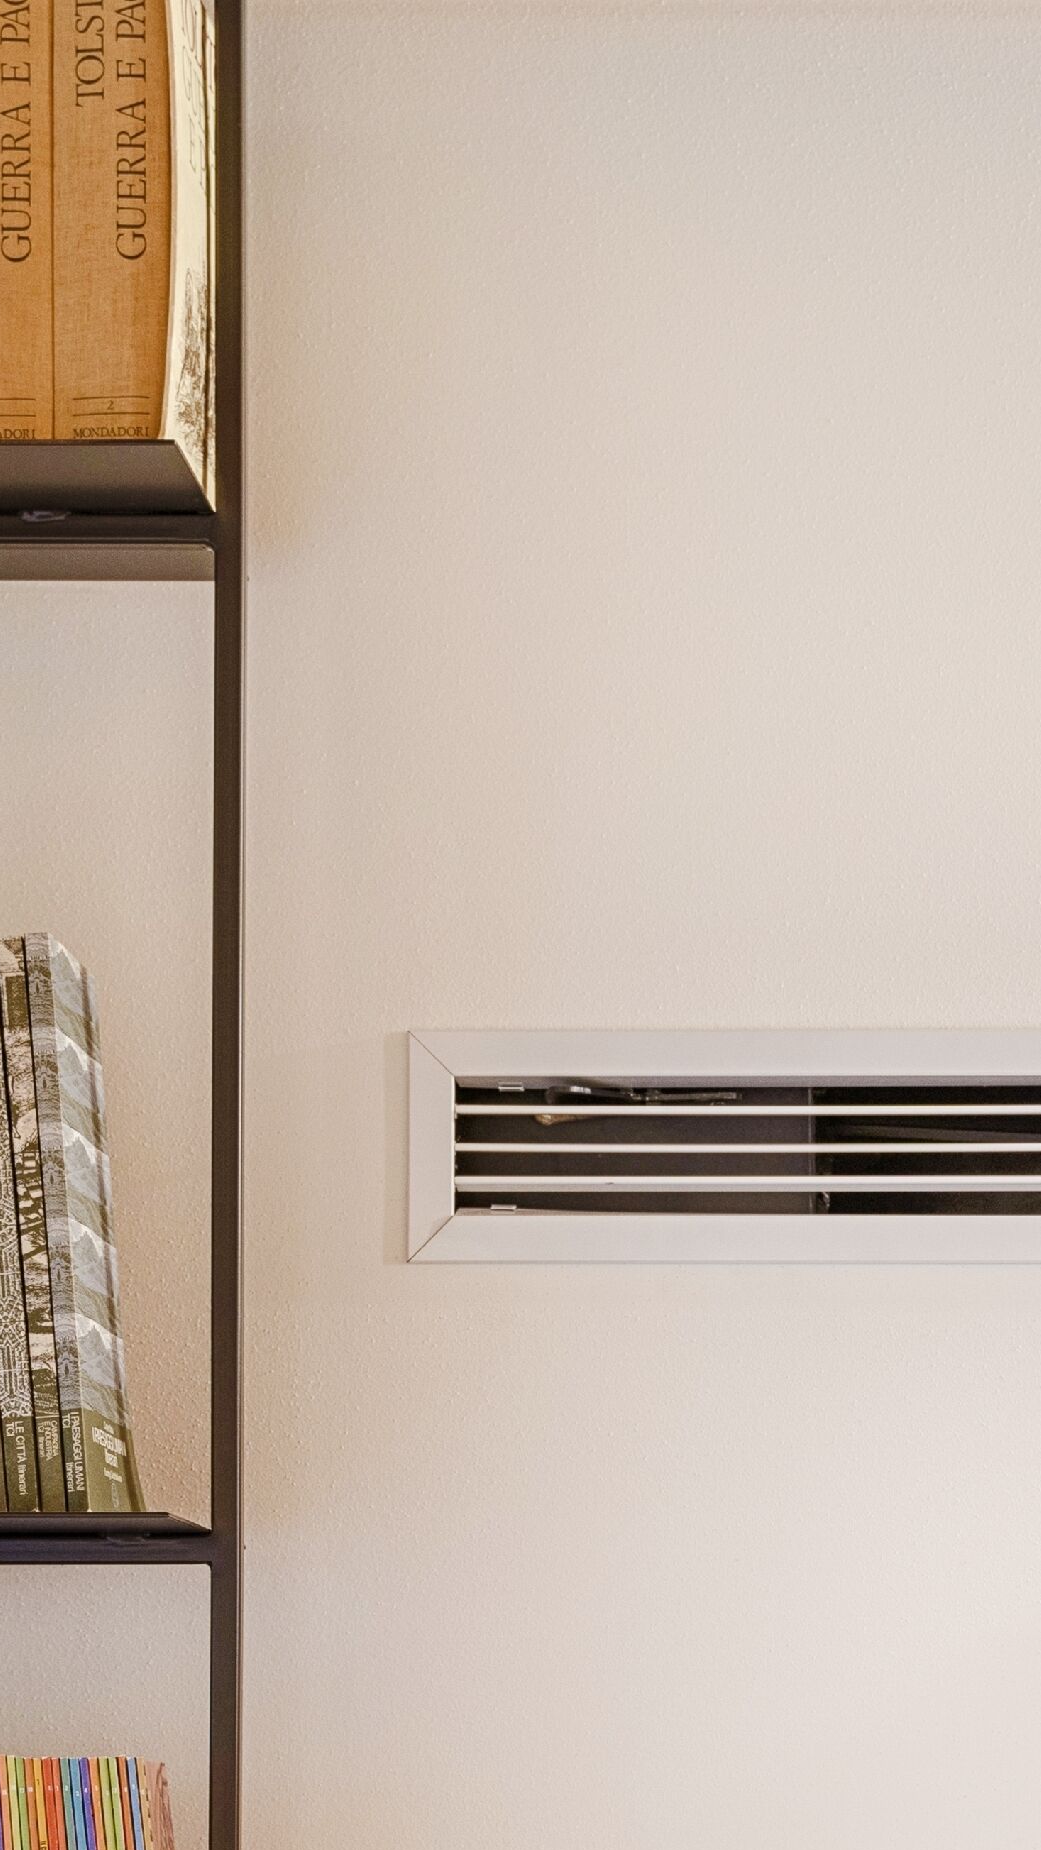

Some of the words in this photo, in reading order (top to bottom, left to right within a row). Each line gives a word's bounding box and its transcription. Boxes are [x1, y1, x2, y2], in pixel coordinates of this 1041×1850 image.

[1, 62, 31, 86] E
[116, 58, 147, 83] E
[0, 102, 32, 263] GUERRA
[115, 98, 147, 261] GUERRA
[107, 400, 115, 411] 2
[72, 426, 149, 438] MONDADORI
